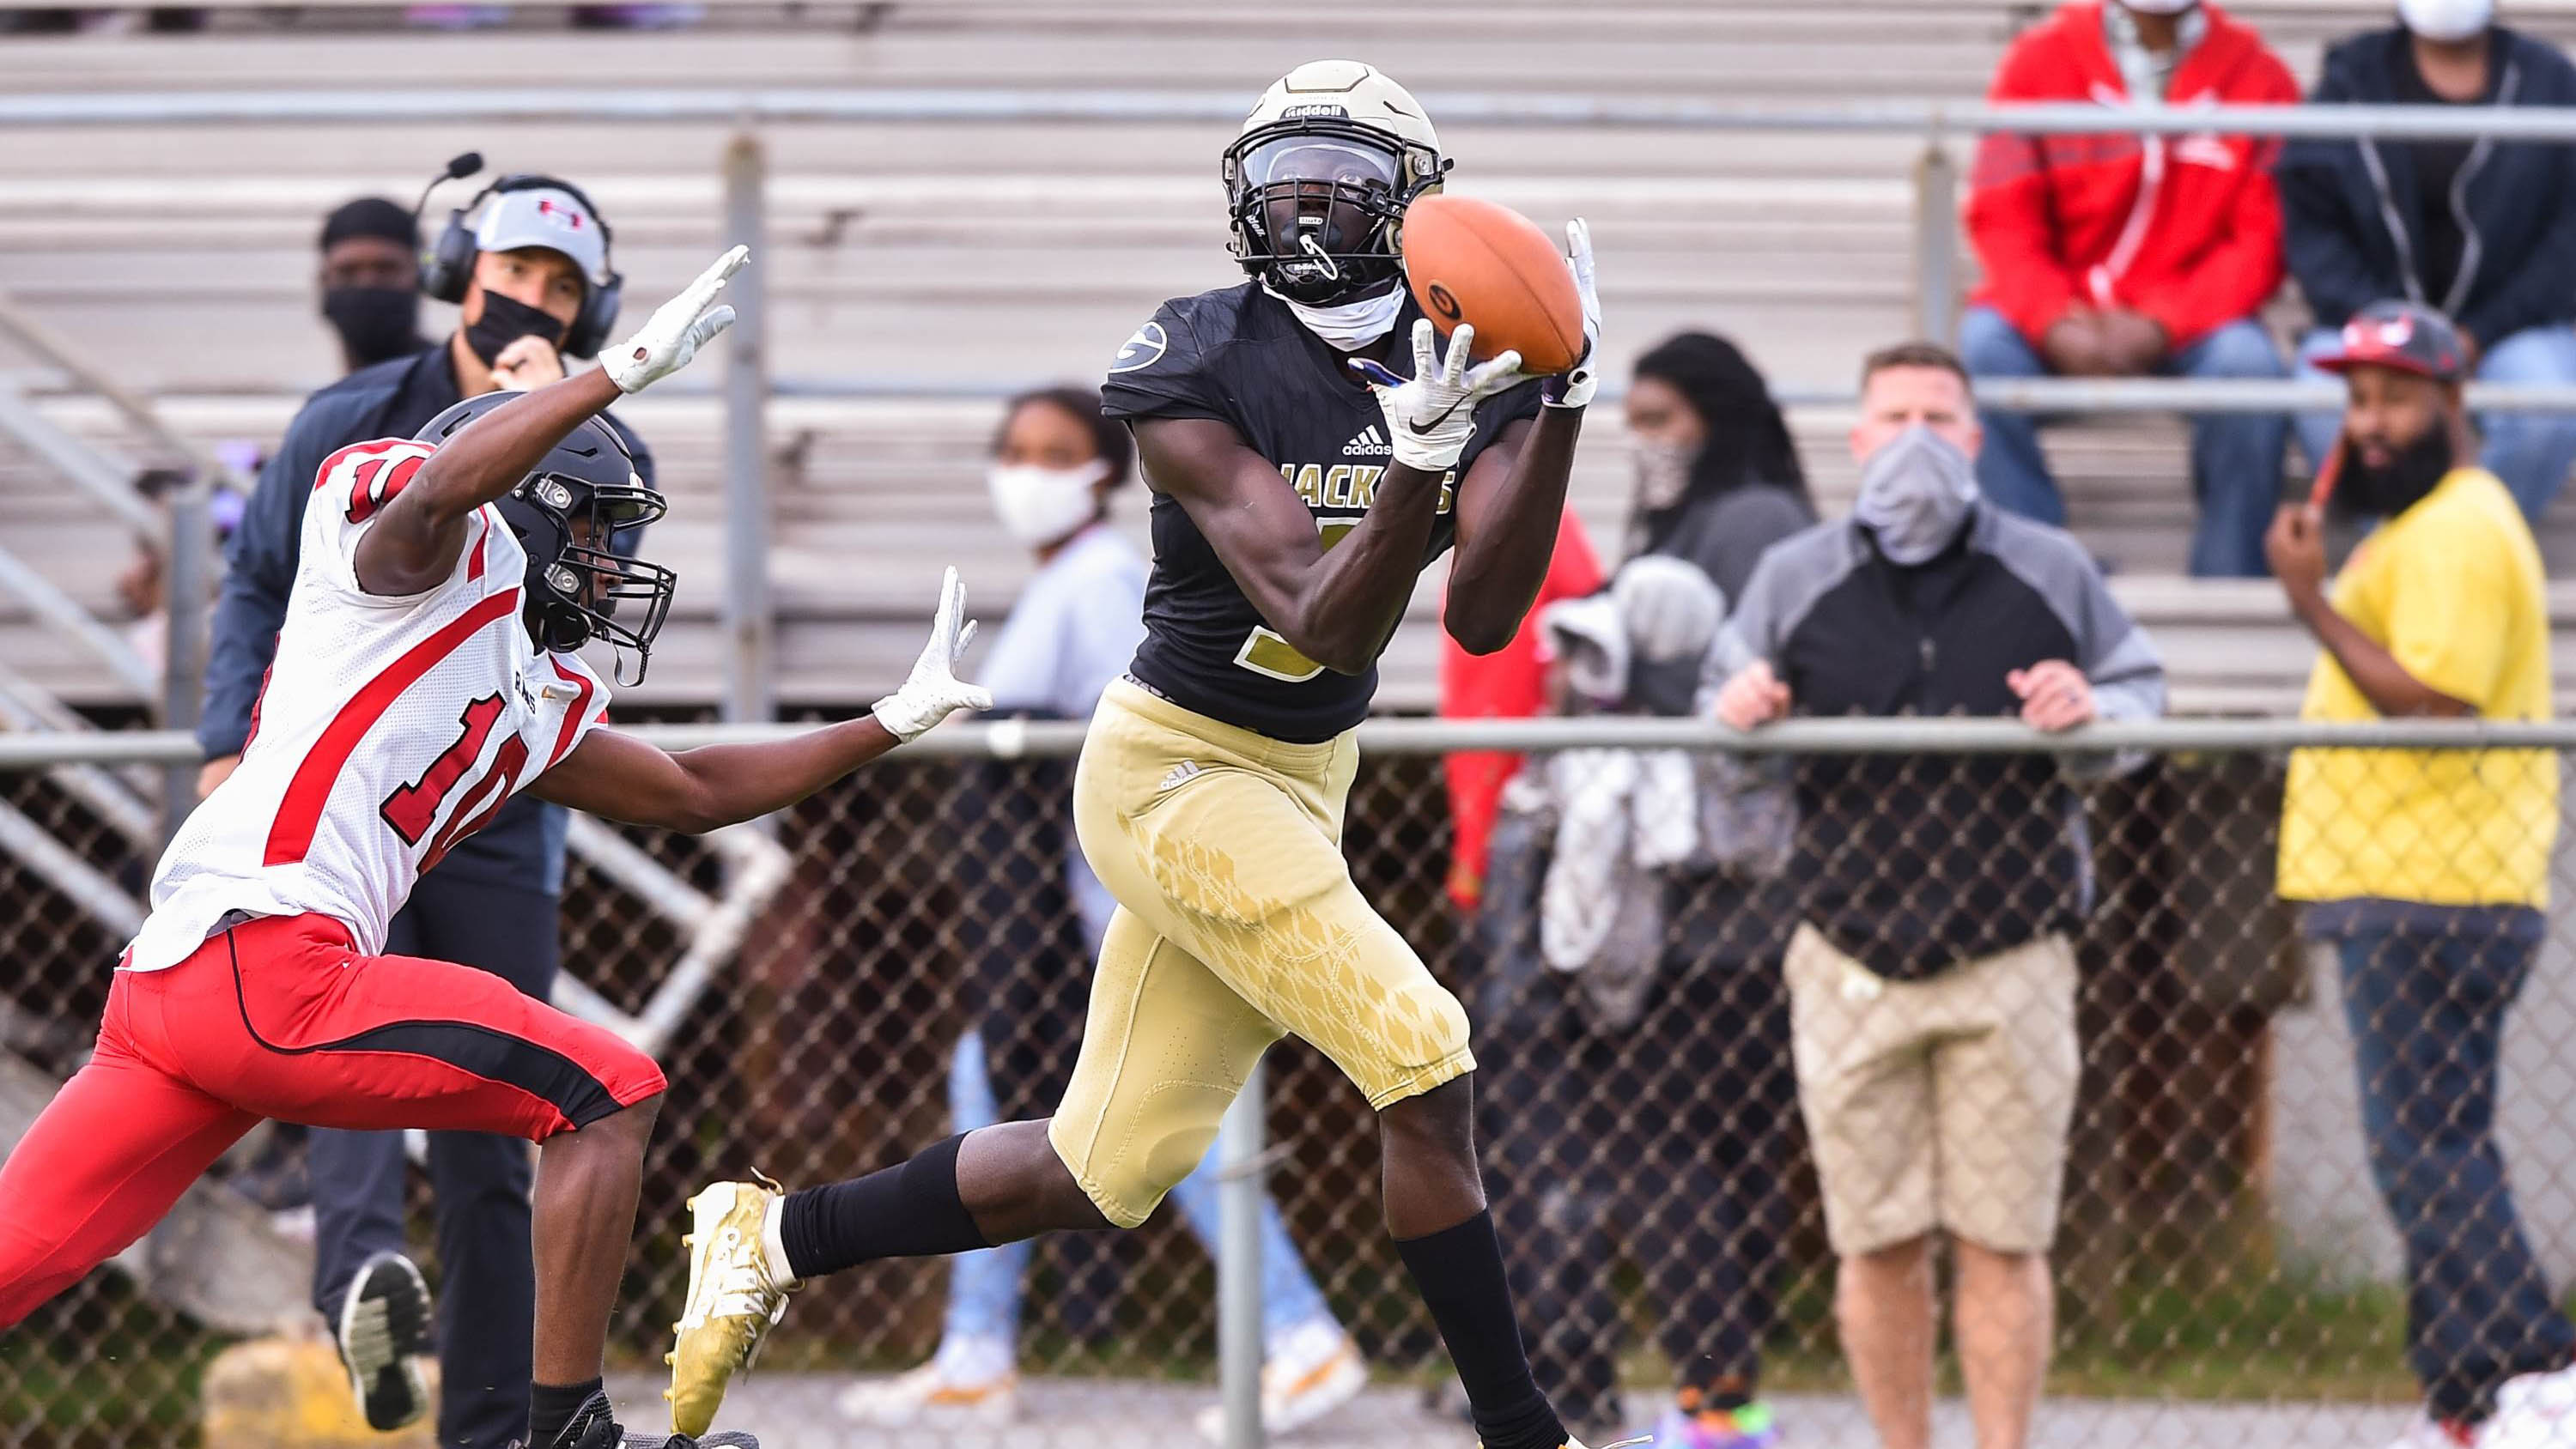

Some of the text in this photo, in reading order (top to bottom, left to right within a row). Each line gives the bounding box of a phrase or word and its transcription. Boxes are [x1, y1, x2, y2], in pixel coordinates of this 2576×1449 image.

[1285, 104, 1342, 118] Riddell
[1342, 443, 1392, 456] adidas
[379, 689, 530, 876] 10
